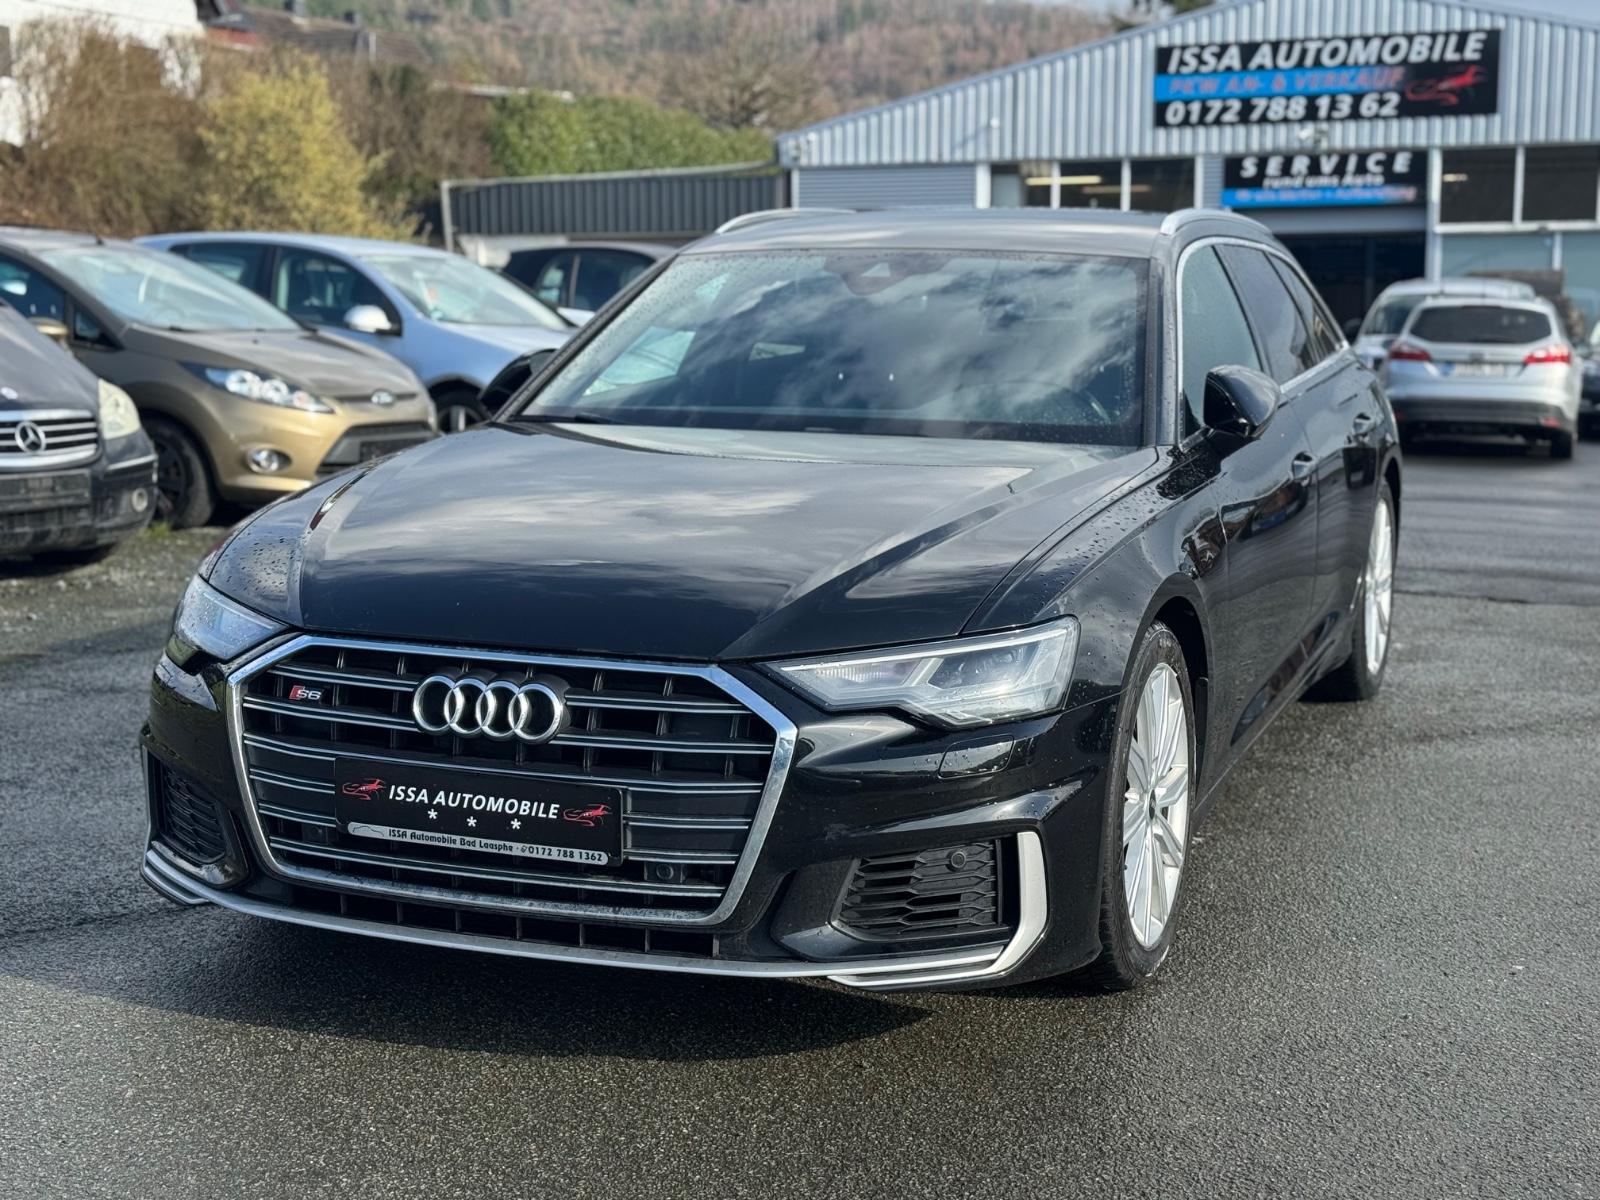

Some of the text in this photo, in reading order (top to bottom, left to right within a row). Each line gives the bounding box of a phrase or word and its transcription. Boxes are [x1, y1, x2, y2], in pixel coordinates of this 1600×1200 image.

[1167, 32, 1487, 74] ISSA AUTOMOBILE
[1169, 76, 1219, 94] PKW
[1294, 66, 1406, 91] VERKAUF
[1165, 91, 1401, 125] 0172 788 13 62
[1240, 151, 1413, 178] SERVICE
[296, 689, 322, 700] S6
[388, 784, 560, 819] ISSA AUTOMOBILE
[388, 828, 603, 862] ISSA Automobile Bad Laasphe 0172 788 1362
